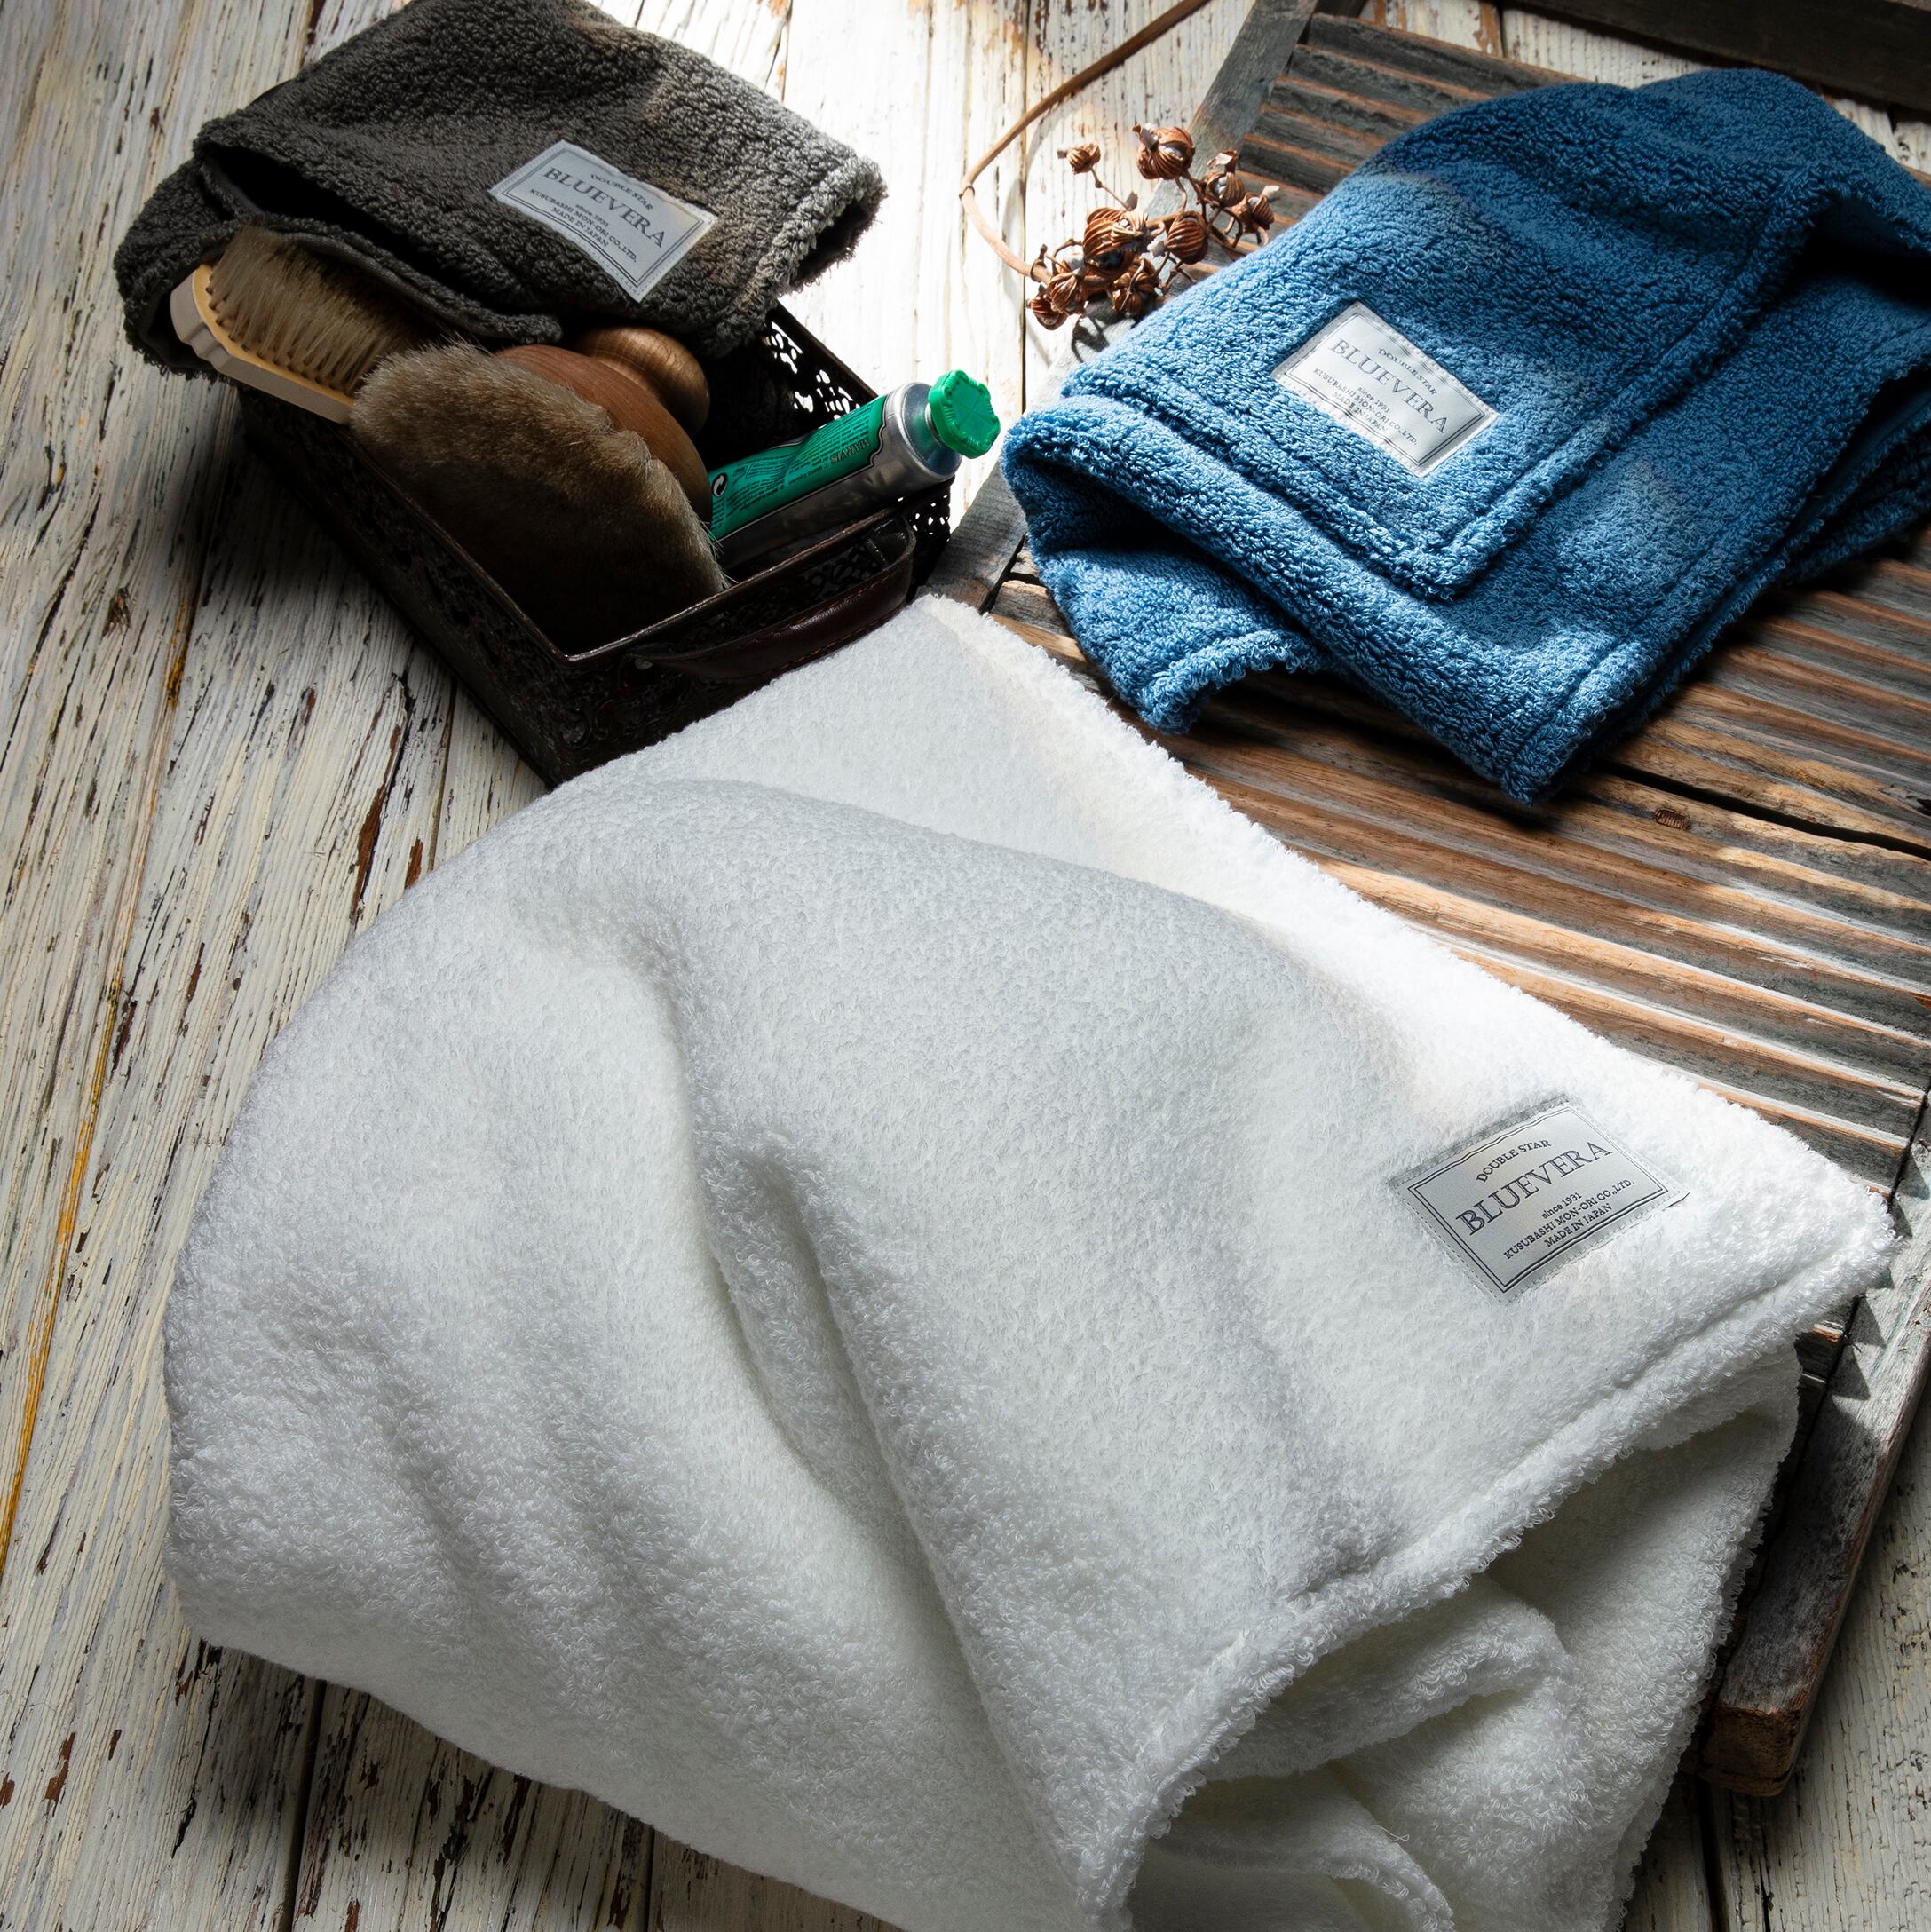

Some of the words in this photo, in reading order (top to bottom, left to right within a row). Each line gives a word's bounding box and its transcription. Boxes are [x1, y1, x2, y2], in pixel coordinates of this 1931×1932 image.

[544, 167, 665, 249] BLUEVERA
[631, 193, 653, 210] STAR
[551, 207, 575, 222] MADE
[574, 220, 586, 229] IN
[585, 226, 609, 247] JAPAN
[574, 210, 610, 237] MON-ORI
[1329, 338, 1448, 433] BLUEVERA
[1357, 386, 1375, 402] since
[1416, 376, 1437, 395] STAR
[1333, 392, 1356, 409] MADE
[1365, 414, 1388, 431] JAPAN
[1354, 395, 1389, 423] MON-ORI
[830, 438, 870, 463] MARVIS
[1476, 1149, 1519, 1183] DOUBLE
[1518, 1140, 1552, 1153] STAR
[1456, 1142, 1613, 1236] BLUEVERA
[1541, 1203, 1563, 1219] since
[1562, 1192, 1583, 1208] 1931
[1503, 1222, 1556, 1260] KUSUBASHI
[1555, 1197, 1598, 1226] MON-ORI
[1544, 1226, 1572, 1247] MADE
[1571, 1219, 1584, 1231] IN
[1583, 1203, 1612, 1224] JAPAN
